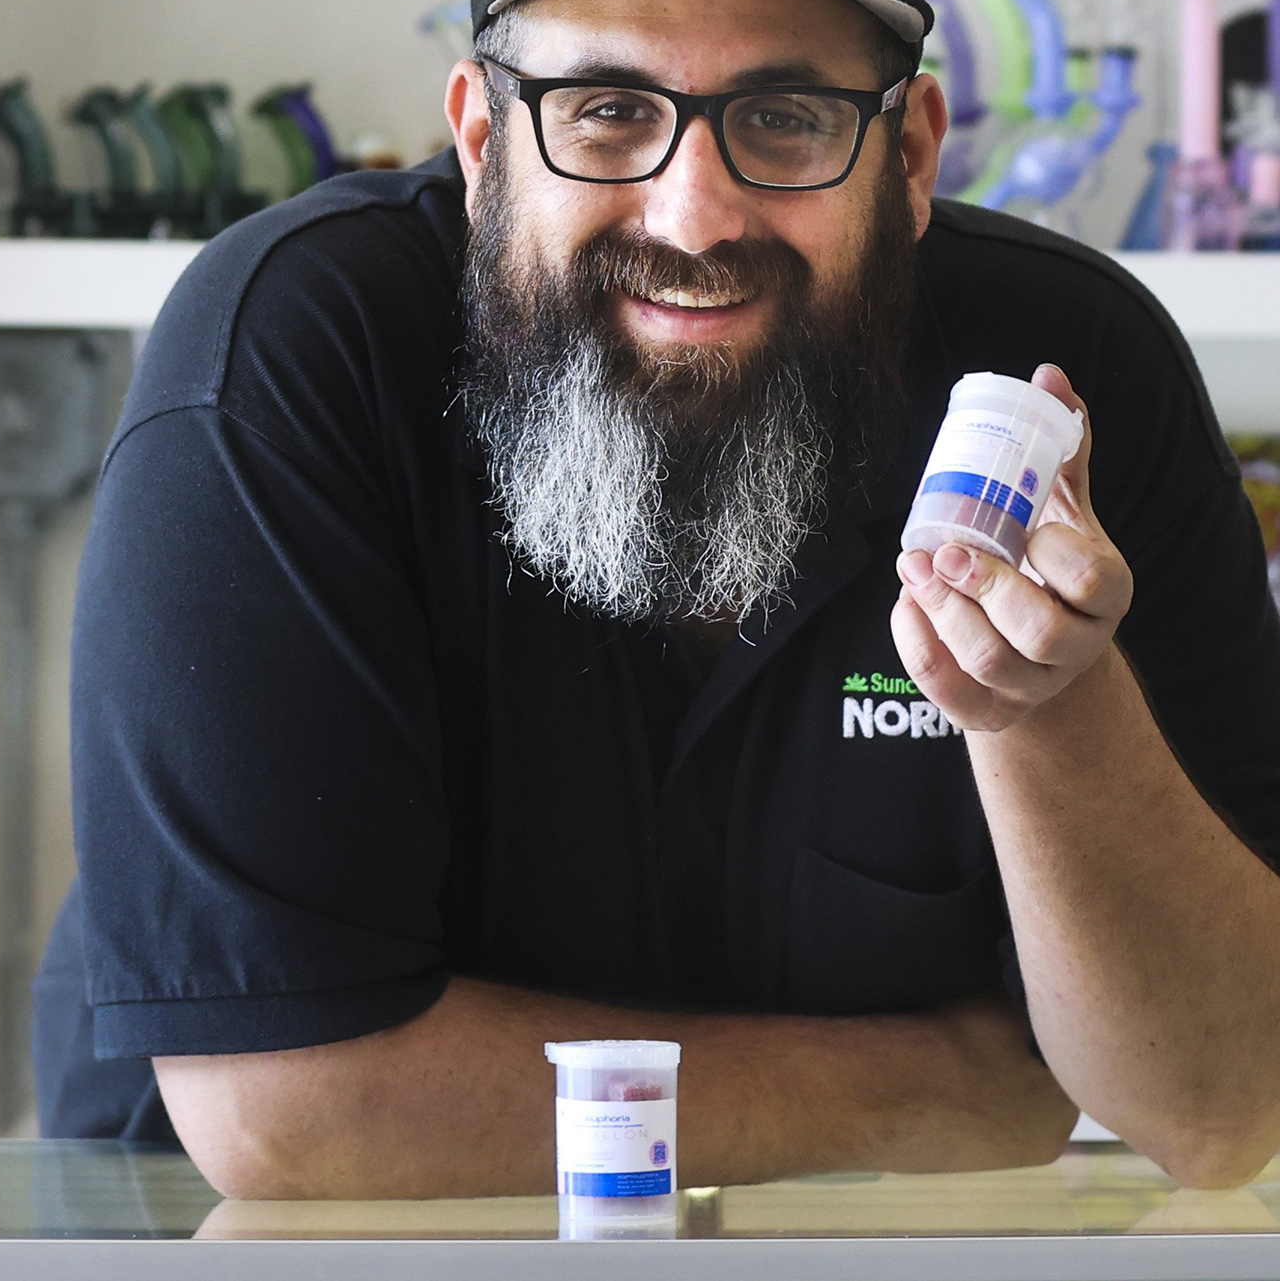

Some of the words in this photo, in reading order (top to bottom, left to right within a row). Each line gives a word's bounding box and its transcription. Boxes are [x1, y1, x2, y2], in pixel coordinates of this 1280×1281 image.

[966, 422, 1012, 435] euphoria
[871, 672, 921, 695] Sunc
[585, 1114, 631, 1124] euphoria
